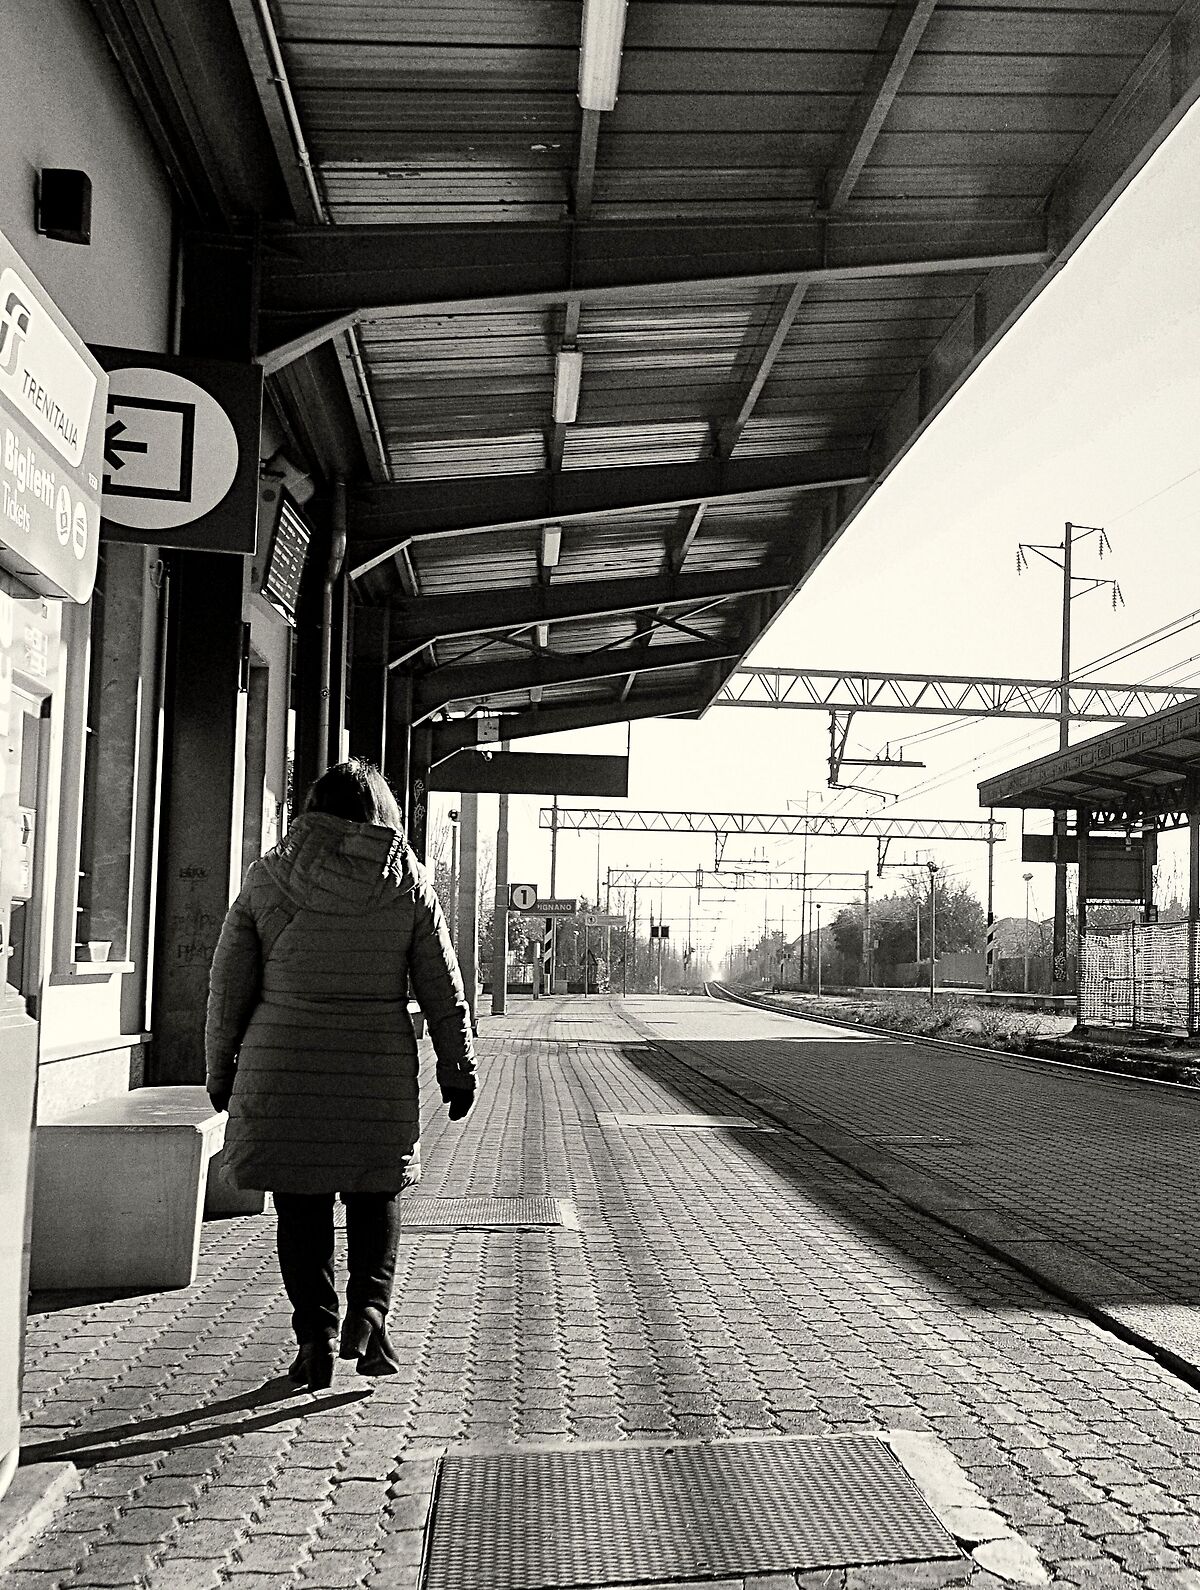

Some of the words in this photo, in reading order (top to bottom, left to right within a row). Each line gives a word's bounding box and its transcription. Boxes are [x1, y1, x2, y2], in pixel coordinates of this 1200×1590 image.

[22, 369, 78, 451] TRENITALIA
[4, 428, 56, 510] Biglietti
[2, 480, 31, 533] Tickets
[520, 889, 527, 905] 1
